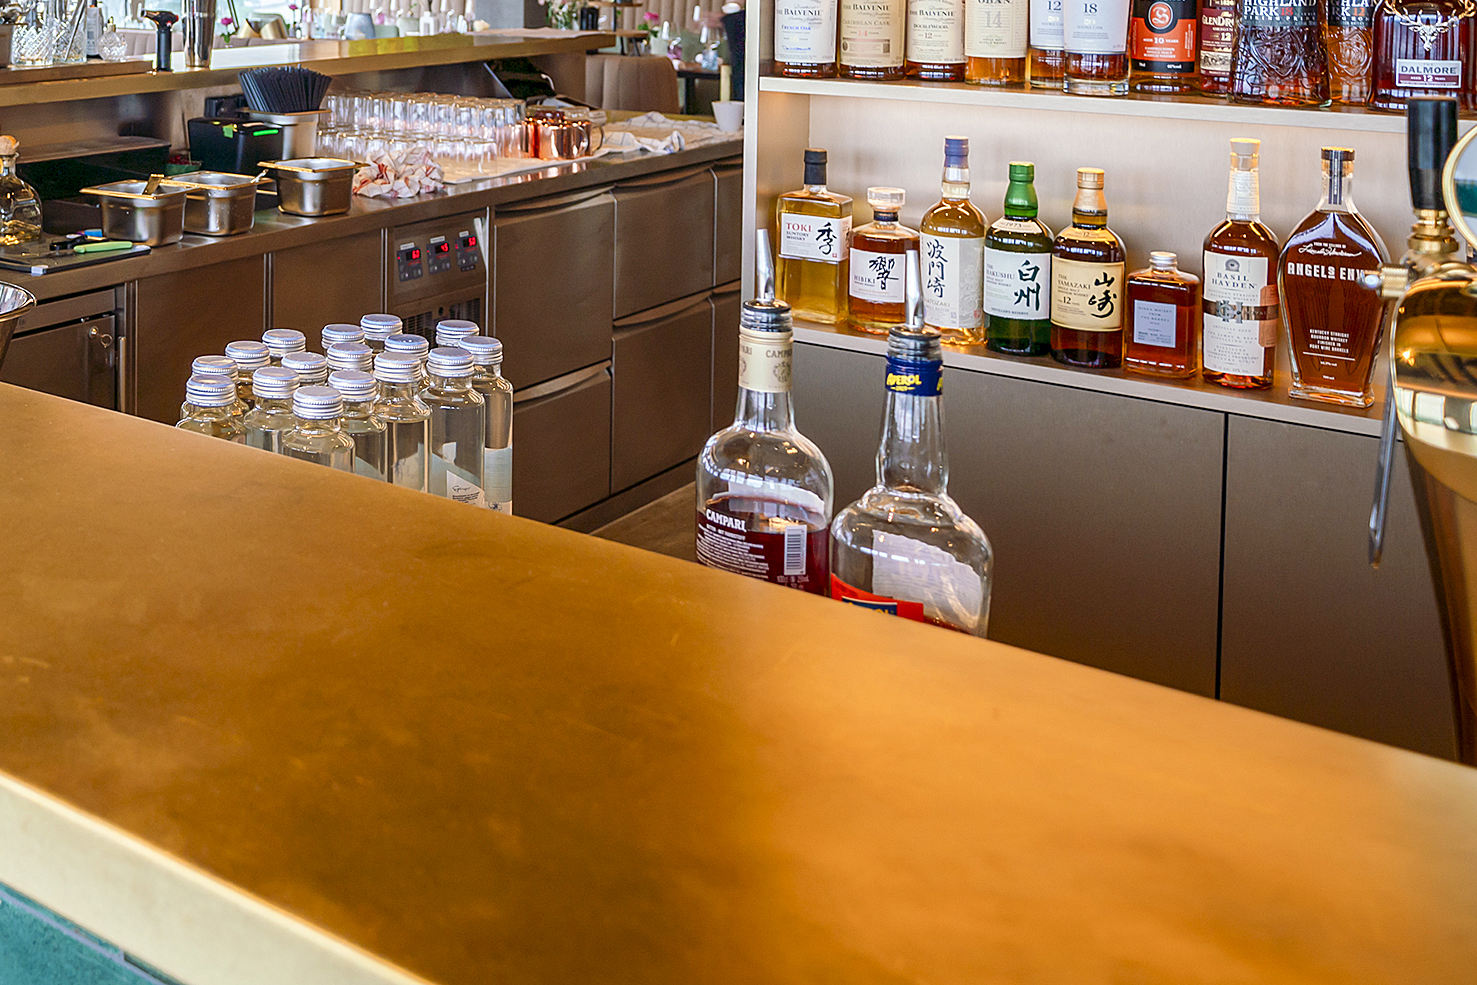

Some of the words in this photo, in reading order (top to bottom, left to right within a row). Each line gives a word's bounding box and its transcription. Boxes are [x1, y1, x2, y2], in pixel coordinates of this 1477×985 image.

[852, 3, 890, 11] BALVENIE
[1047, 1, 1062, 11] 12
[1083, 2, 1098, 14] 18
[919, 9, 954, 17] BALVENIE
[1244, 6, 1280, 17] PARK
[1281, 6, 1294, 16] 18
[1353, 7, 1366, 16] 12
[984, 10, 1003, 28] 14
[1220, 32, 1232, 41] 12
[1400, 65, 1457, 74] DALMORE
[1423, 74, 1433, 82] 12
[785, 222, 812, 232] TOKI
[815, 221, 838, 255] 季
[1287, 261, 1335, 279] ANGELS
[854, 274, 876, 284] HIBIKI
[1217, 272, 1249, 282] BASIL
[1013, 259, 1041, 312] 白州
[1057, 280, 1091, 290] YAMAZAKI
[1211, 278, 1255, 290] HAYDEN
[1062, 296, 1071, 305] 12
[886, 372, 922, 386] APEROL
[706, 508, 747, 533] CAMPARI
